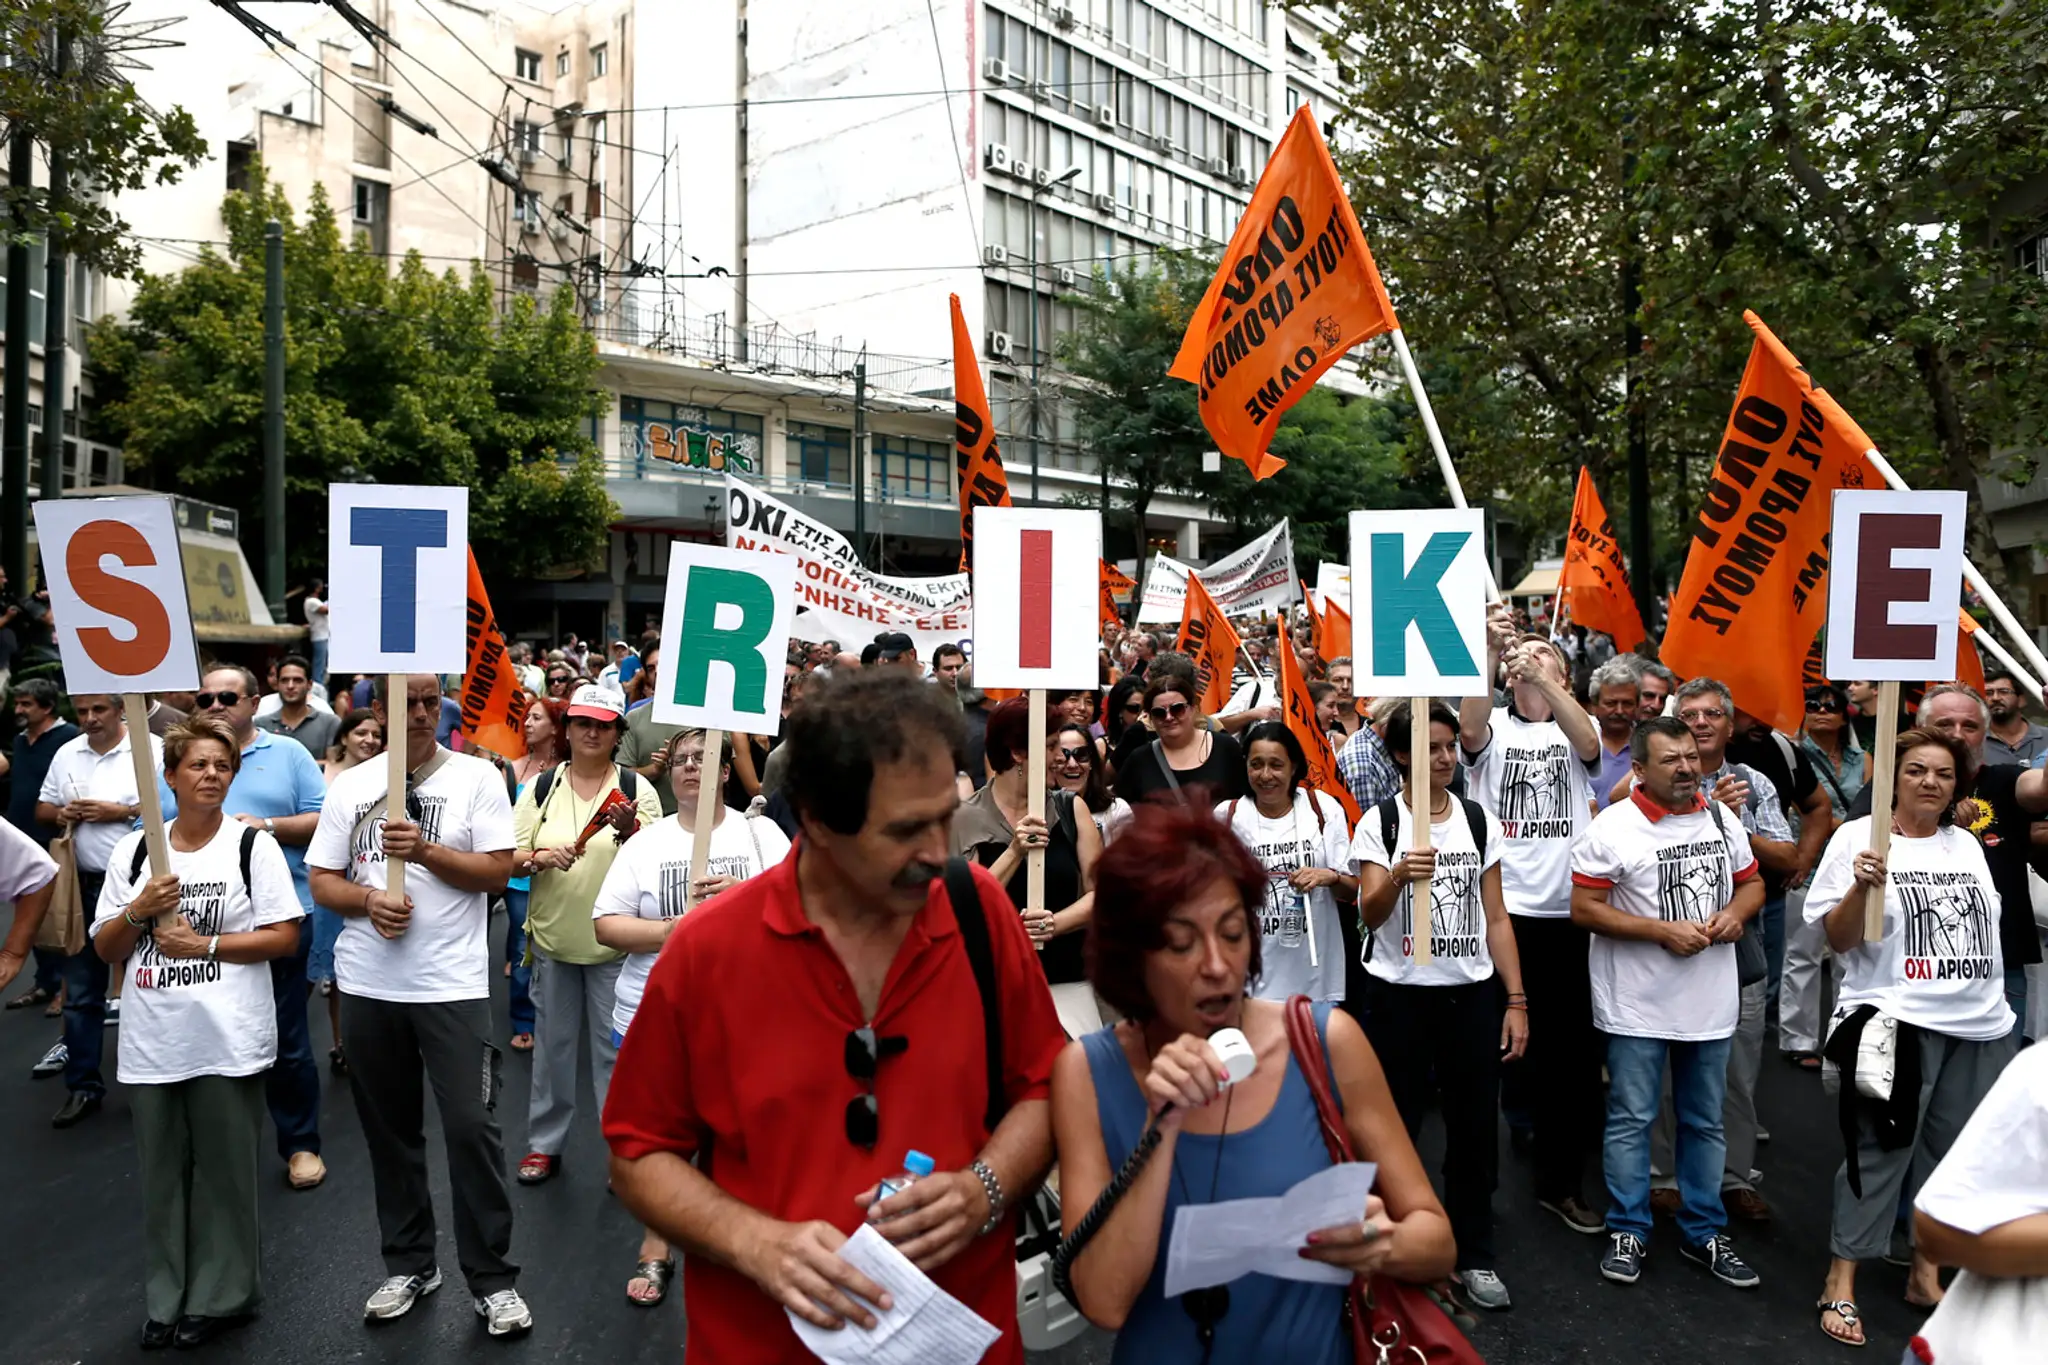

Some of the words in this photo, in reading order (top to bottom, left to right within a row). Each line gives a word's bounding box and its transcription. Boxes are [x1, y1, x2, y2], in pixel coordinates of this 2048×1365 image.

[1521, 820, 1573, 838] ΑΡΙΘΜΟΙ
[157, 960, 220, 988] ΑΡΙΘΜΟΙ
[1905, 958, 1932, 980] ΟΧΙ
[1937, 958, 1993, 980] ΑΡΙΘΜΟΙ
